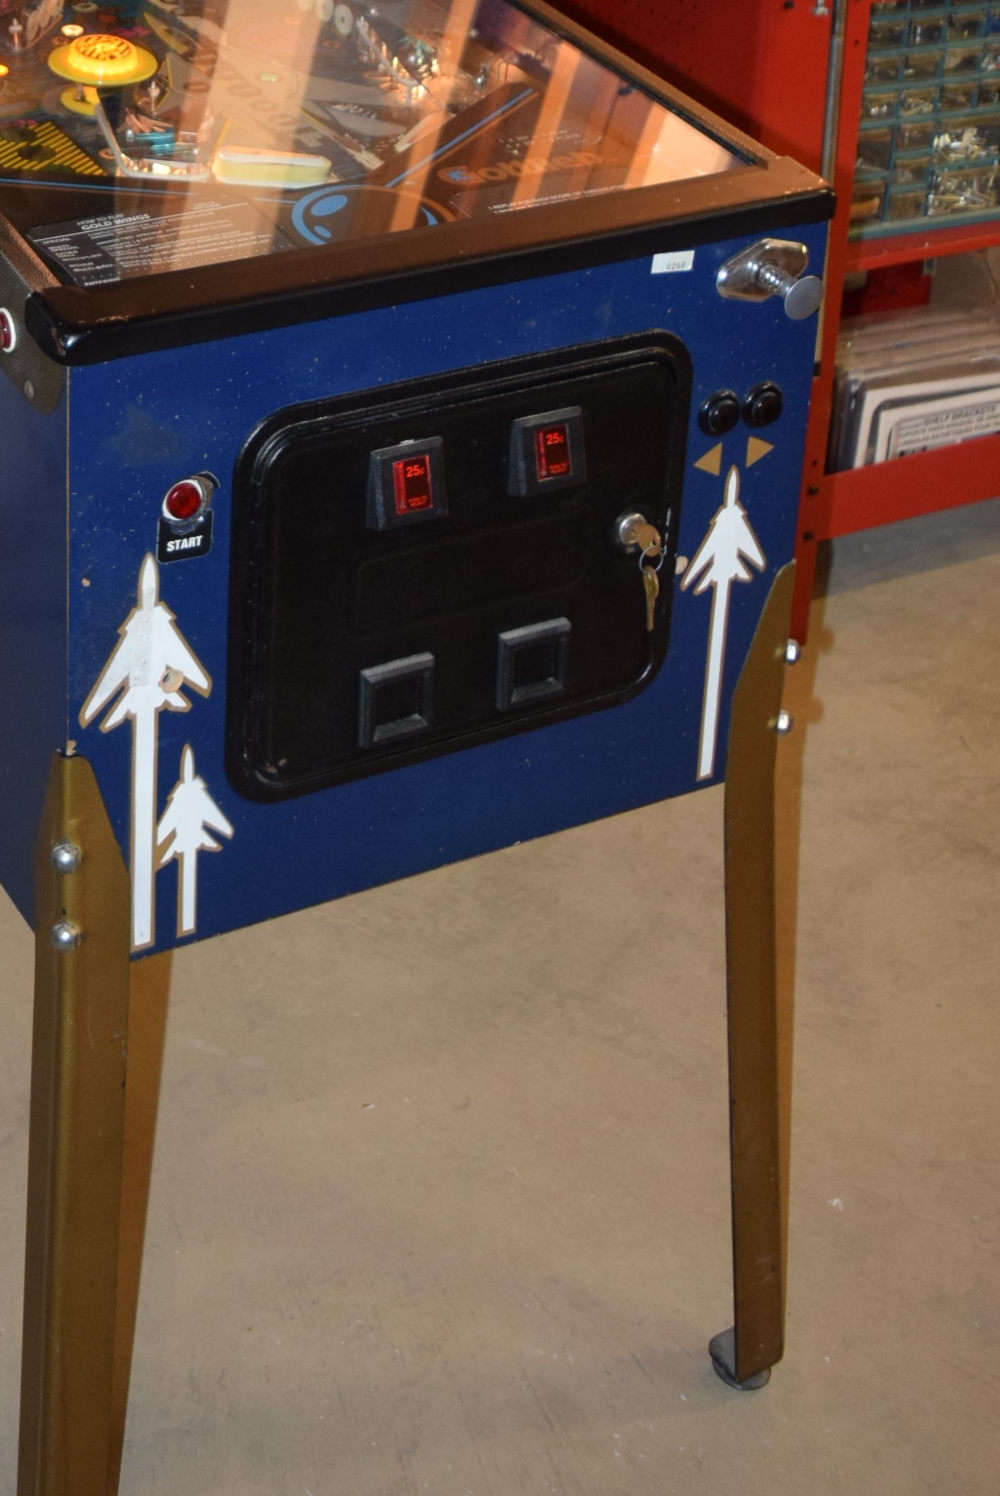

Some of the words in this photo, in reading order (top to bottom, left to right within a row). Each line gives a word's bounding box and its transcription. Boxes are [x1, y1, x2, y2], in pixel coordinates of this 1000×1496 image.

[81, 221, 112, 231] GOLD
[113, 213, 150, 224] WINGS
[166, 535, 203, 552] START
